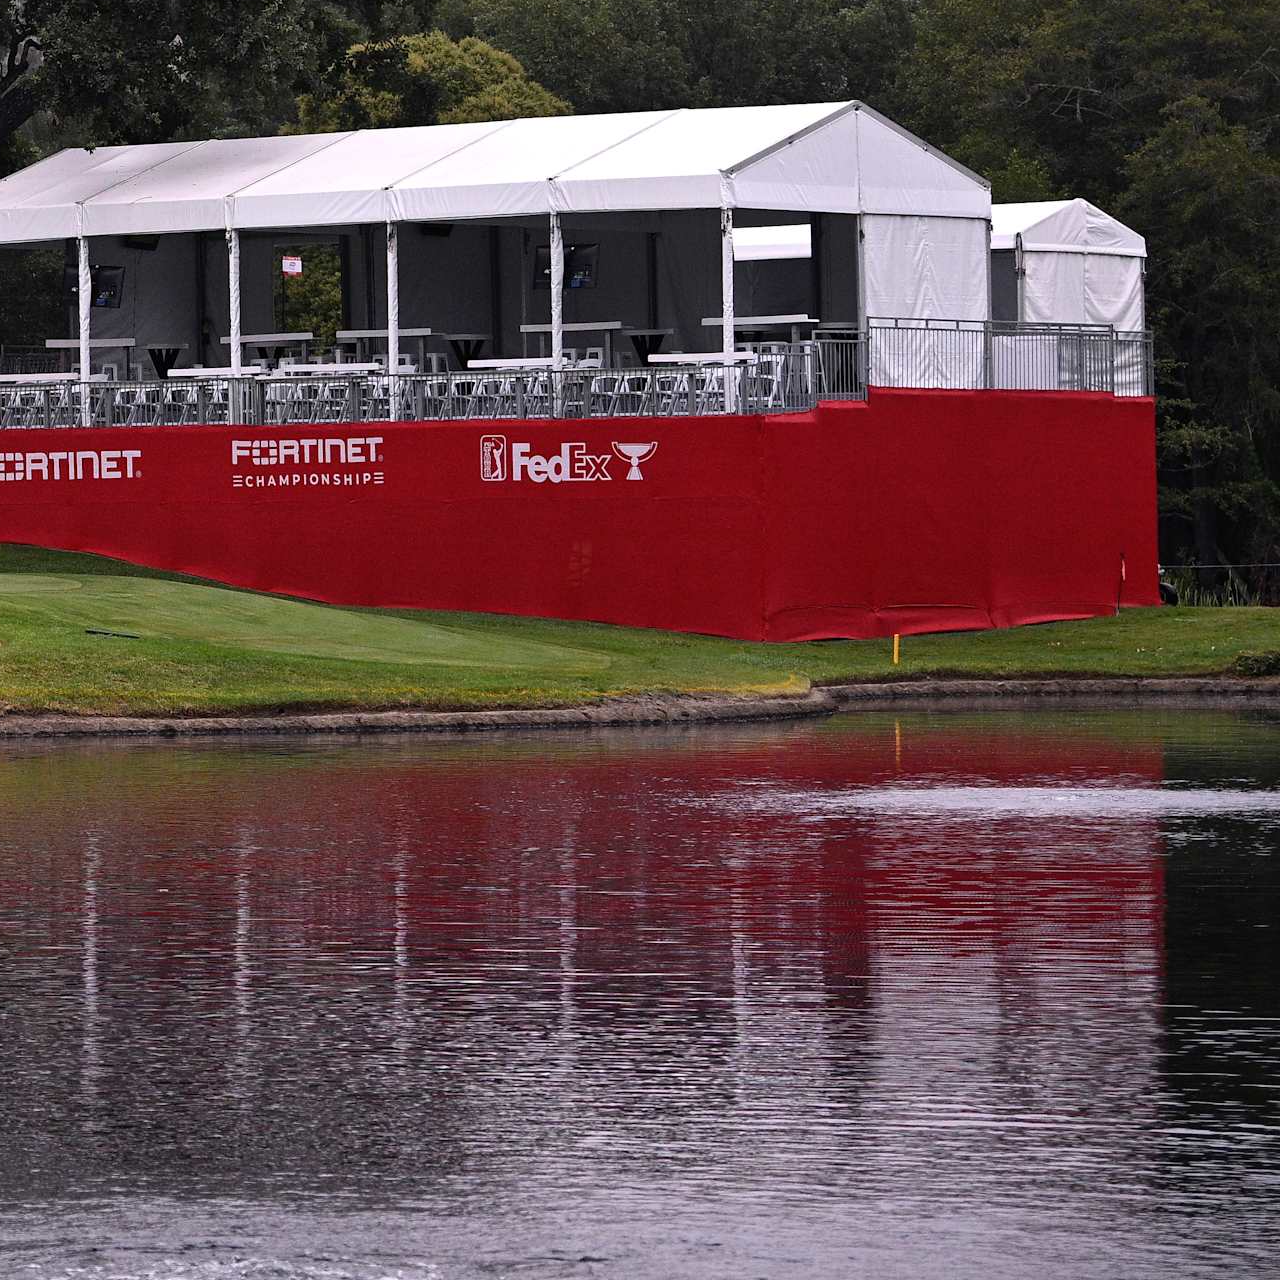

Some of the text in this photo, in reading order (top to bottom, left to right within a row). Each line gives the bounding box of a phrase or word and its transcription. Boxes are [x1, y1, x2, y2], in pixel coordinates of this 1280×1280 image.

[231, 437, 384, 465] FORTINET
[512, 442, 612, 483] FedEx
[245, 472, 372, 487] CHAMPIONSHIP
